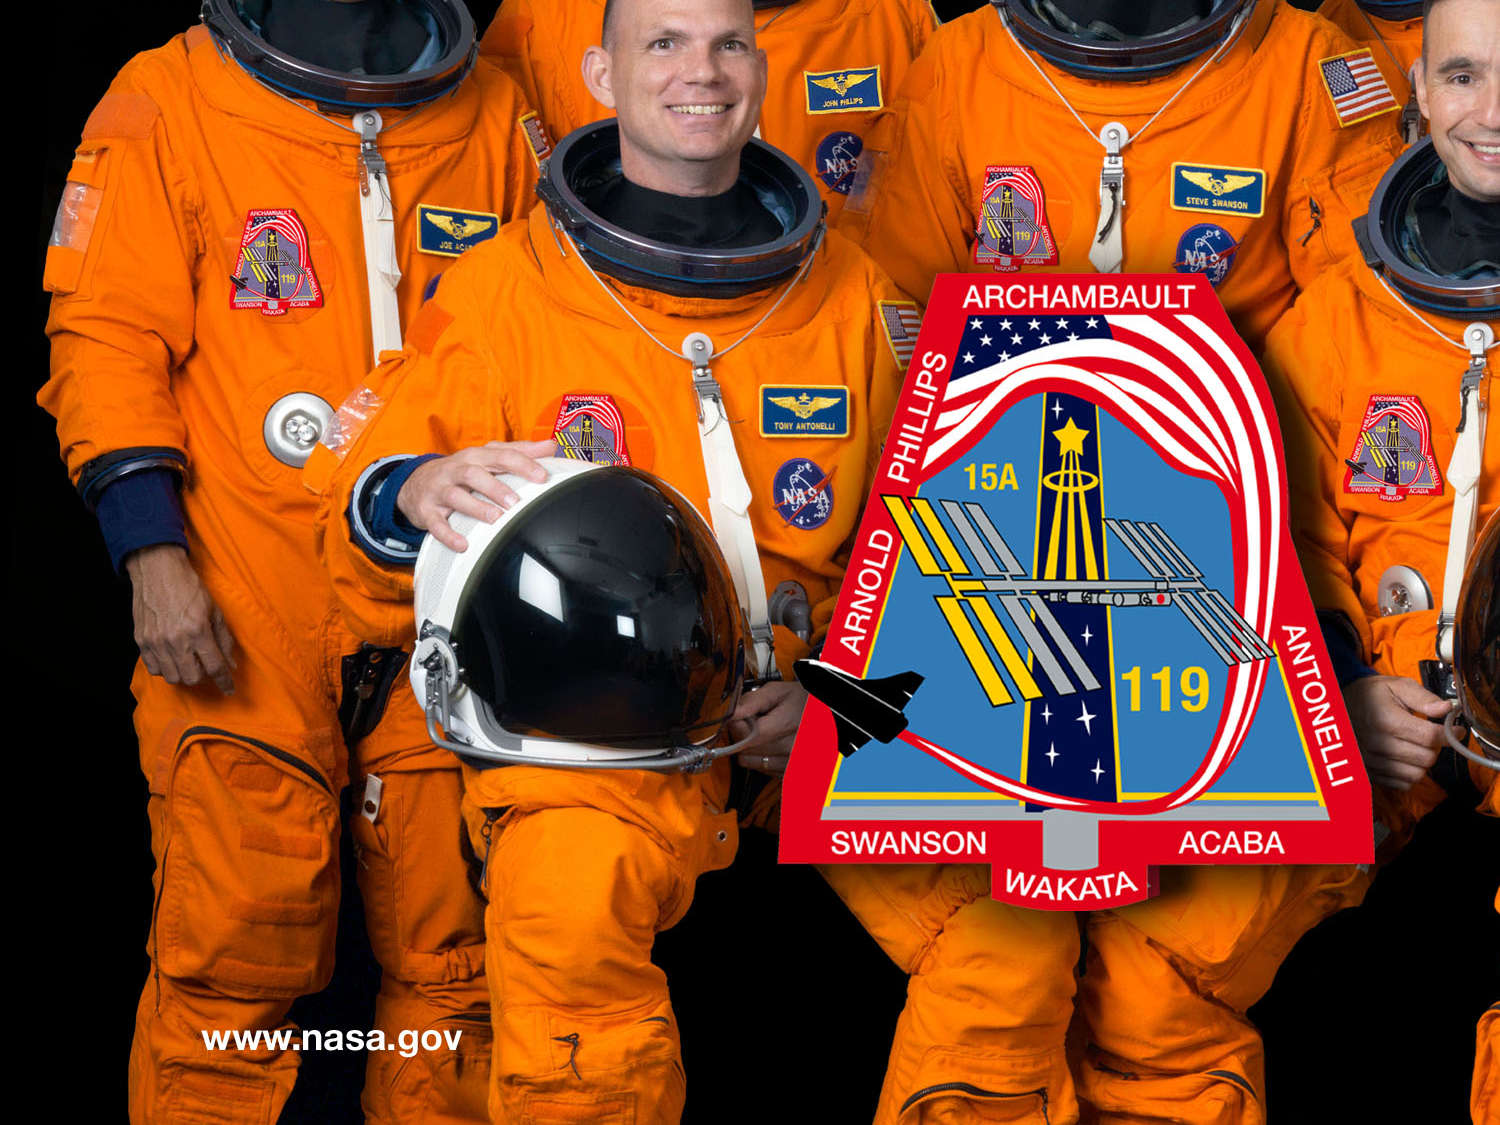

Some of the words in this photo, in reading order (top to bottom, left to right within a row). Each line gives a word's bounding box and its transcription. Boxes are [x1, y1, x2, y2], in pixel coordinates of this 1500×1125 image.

[823, 100, 838, 108] JOHN
[825, 158, 858, 174] NAS
[1186, 197, 1209, 206] STEVE
[1212, 199, 1248, 209] SWANSON
[1016, 231, 1030, 241] 119
[440, 241, 453, 249] JOE
[1184, 249, 1228, 269] NASA
[281, 274, 295, 283] 119
[774, 422, 793, 430] TONY
[1401, 461, 1416, 470] 119
[782, 488, 830, 506] NASA
